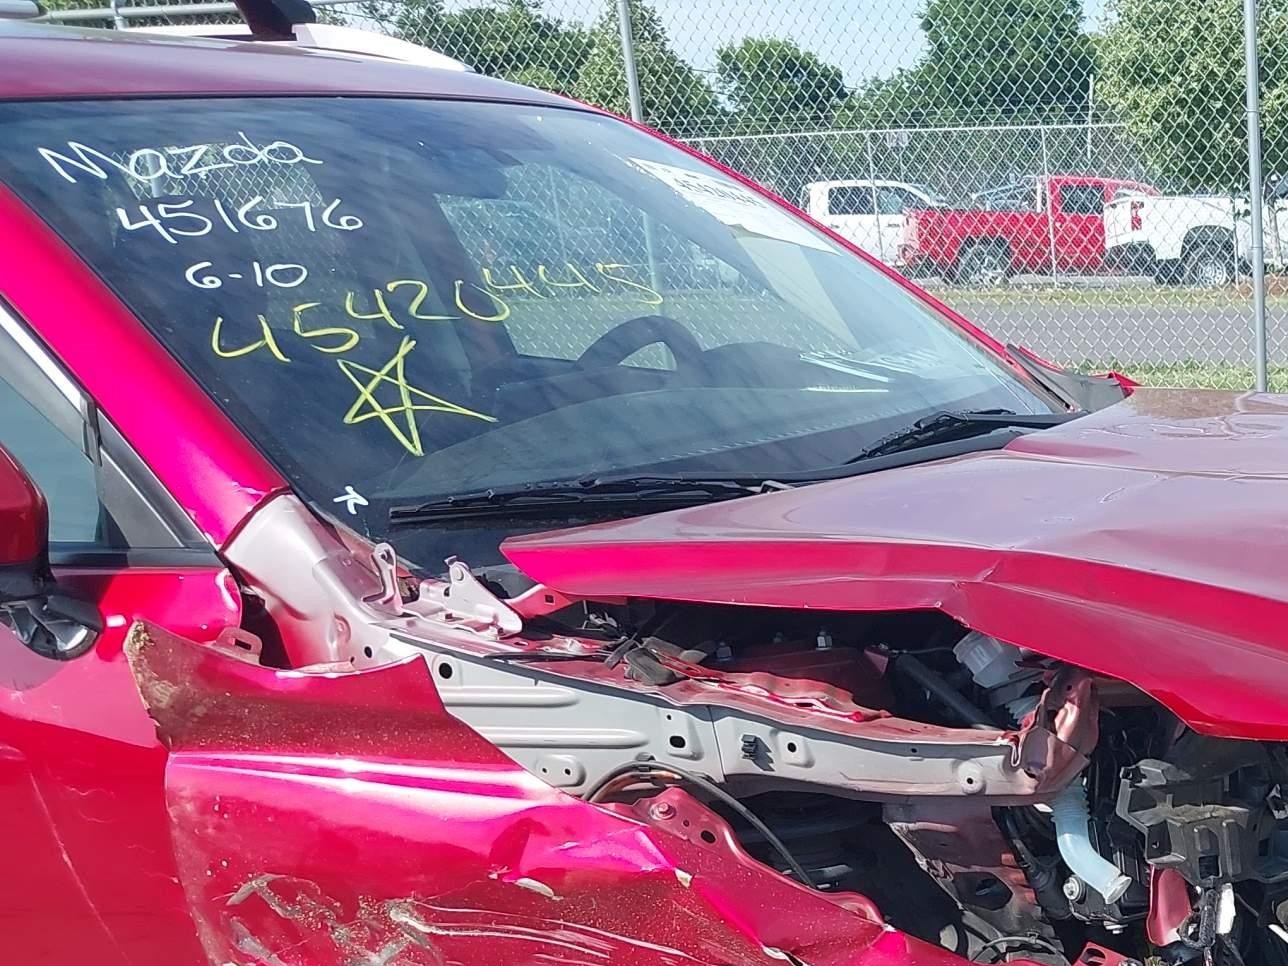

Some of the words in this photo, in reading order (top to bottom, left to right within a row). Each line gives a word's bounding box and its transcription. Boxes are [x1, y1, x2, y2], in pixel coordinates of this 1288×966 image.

[37, 131, 323, 183] Mazda
[116, 198, 363, 244] 451676
[184, 260, 308, 289] 6-10
